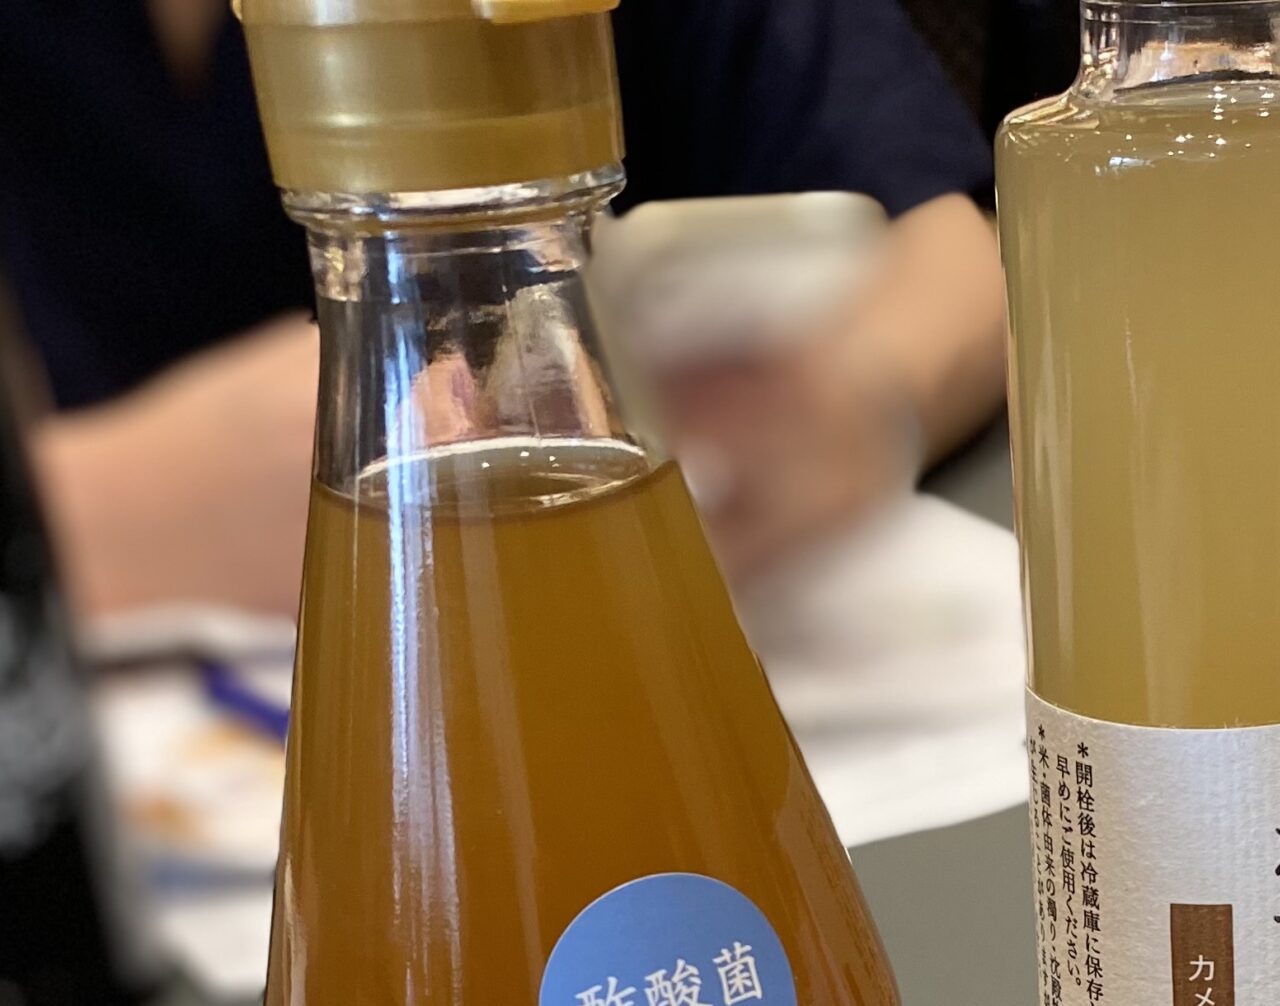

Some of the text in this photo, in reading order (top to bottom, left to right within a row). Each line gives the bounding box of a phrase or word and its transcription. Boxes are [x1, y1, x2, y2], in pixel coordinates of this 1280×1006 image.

[1055, 754, 1083, 988] 早めにご使用ください。
